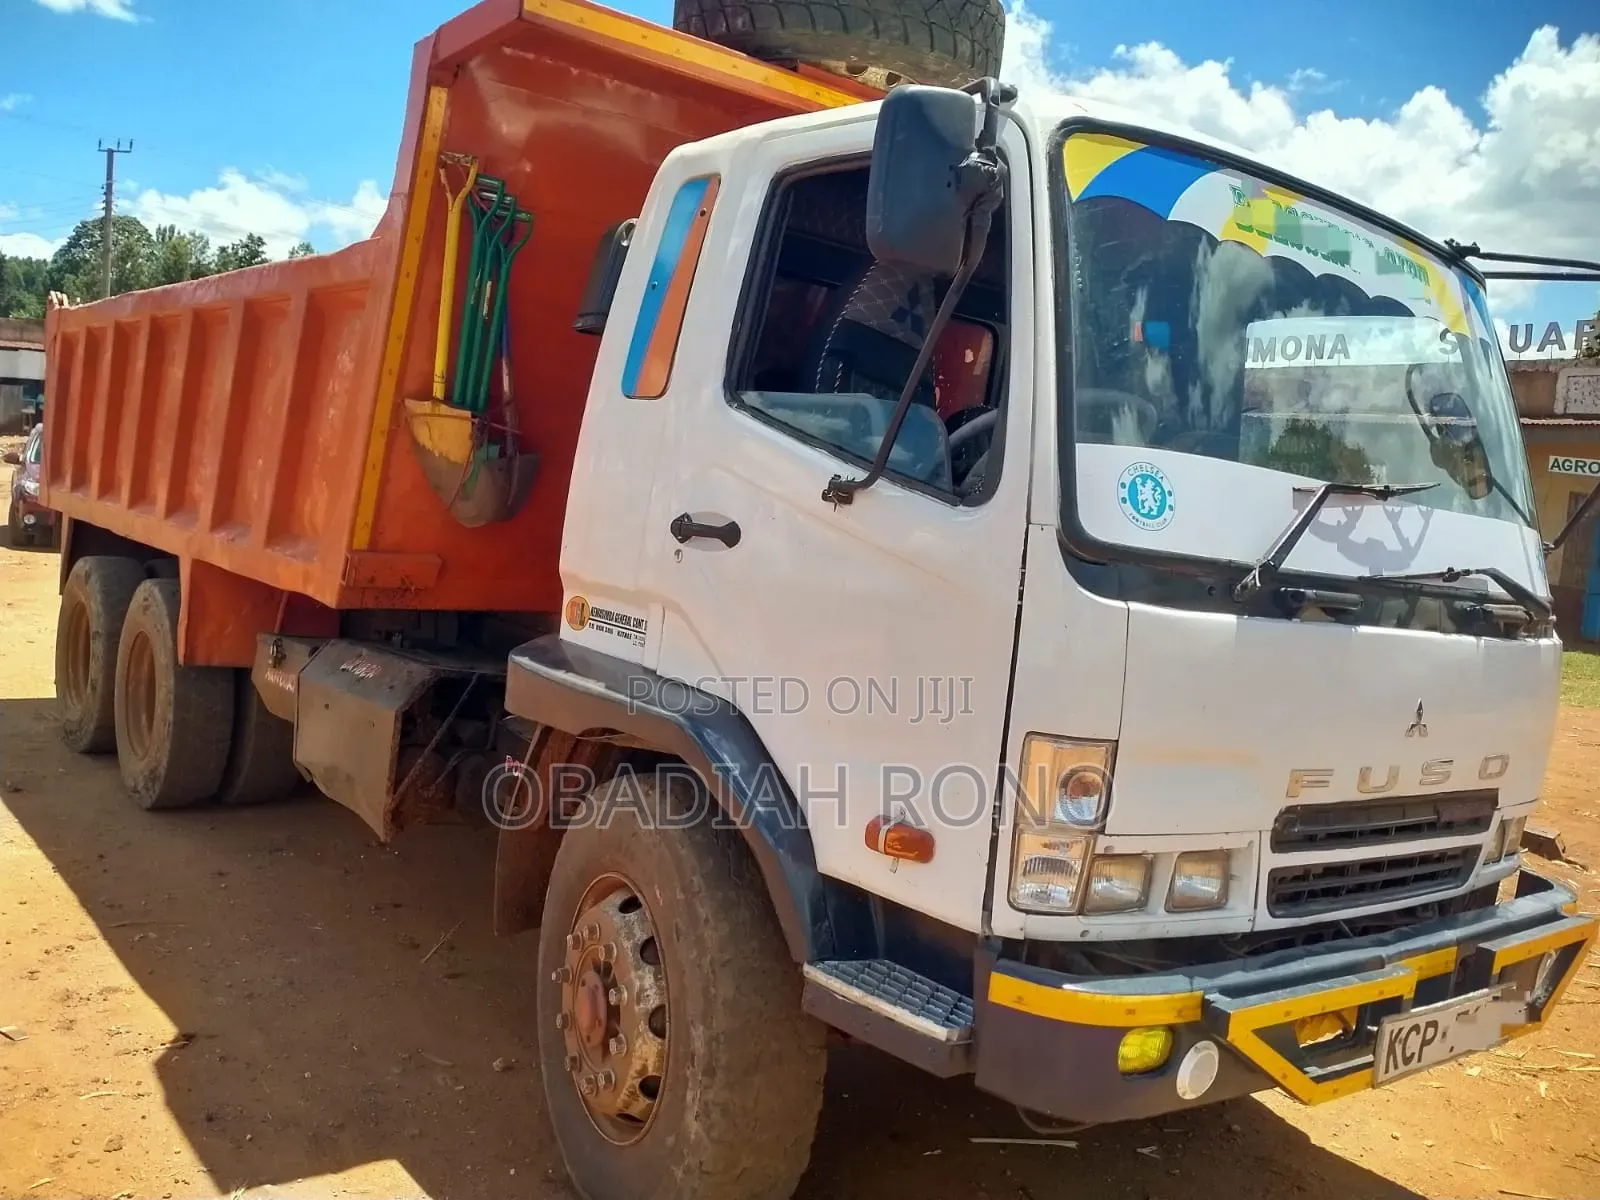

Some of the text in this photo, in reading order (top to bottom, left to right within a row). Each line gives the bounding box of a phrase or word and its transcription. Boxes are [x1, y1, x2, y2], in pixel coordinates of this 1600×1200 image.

[1127, 464, 1165, 482] CHELSEA
[1550, 457, 1600, 474] AGRO
[1285, 754, 1510, 798] FUSO
[1384, 1019, 1440, 1075] KCP
